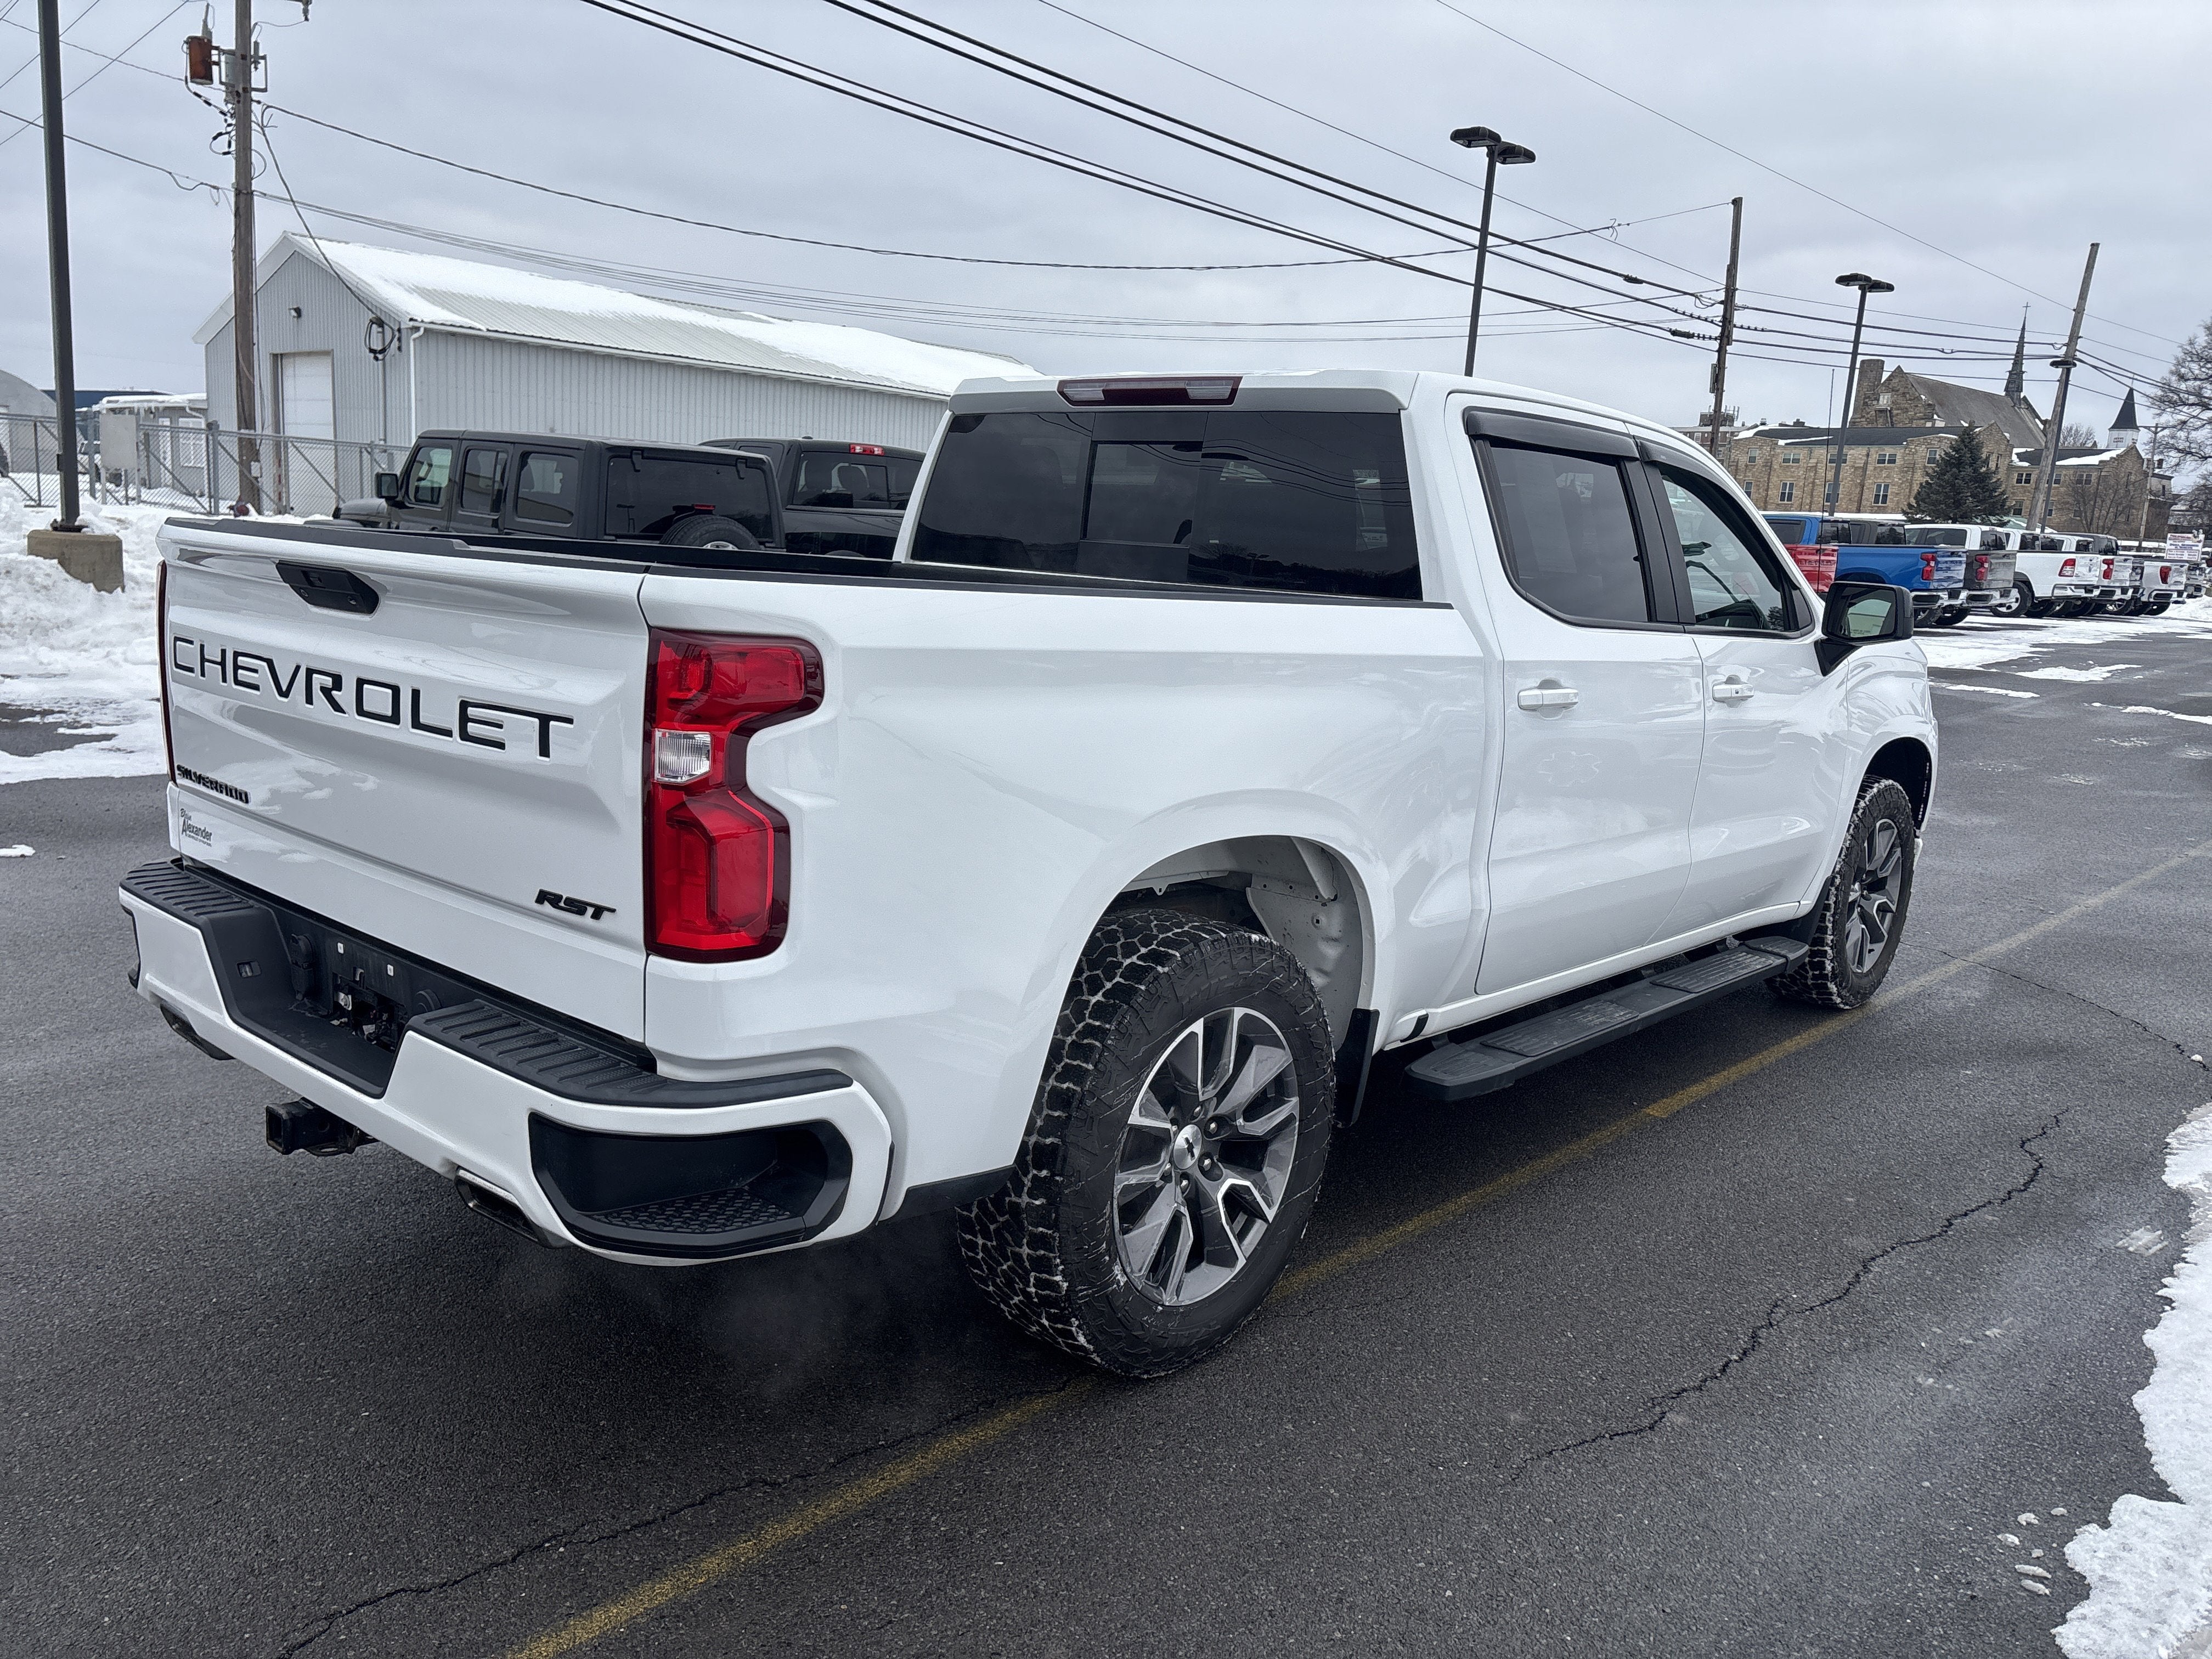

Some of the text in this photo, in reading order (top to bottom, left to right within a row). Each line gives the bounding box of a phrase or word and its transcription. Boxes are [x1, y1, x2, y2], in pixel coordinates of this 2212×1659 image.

[173, 635, 574, 759] CHEVROLET
[176, 764, 250, 804] SILVERADO
[182, 818, 212, 842] Alexander
[534, 889, 617, 920] RST
